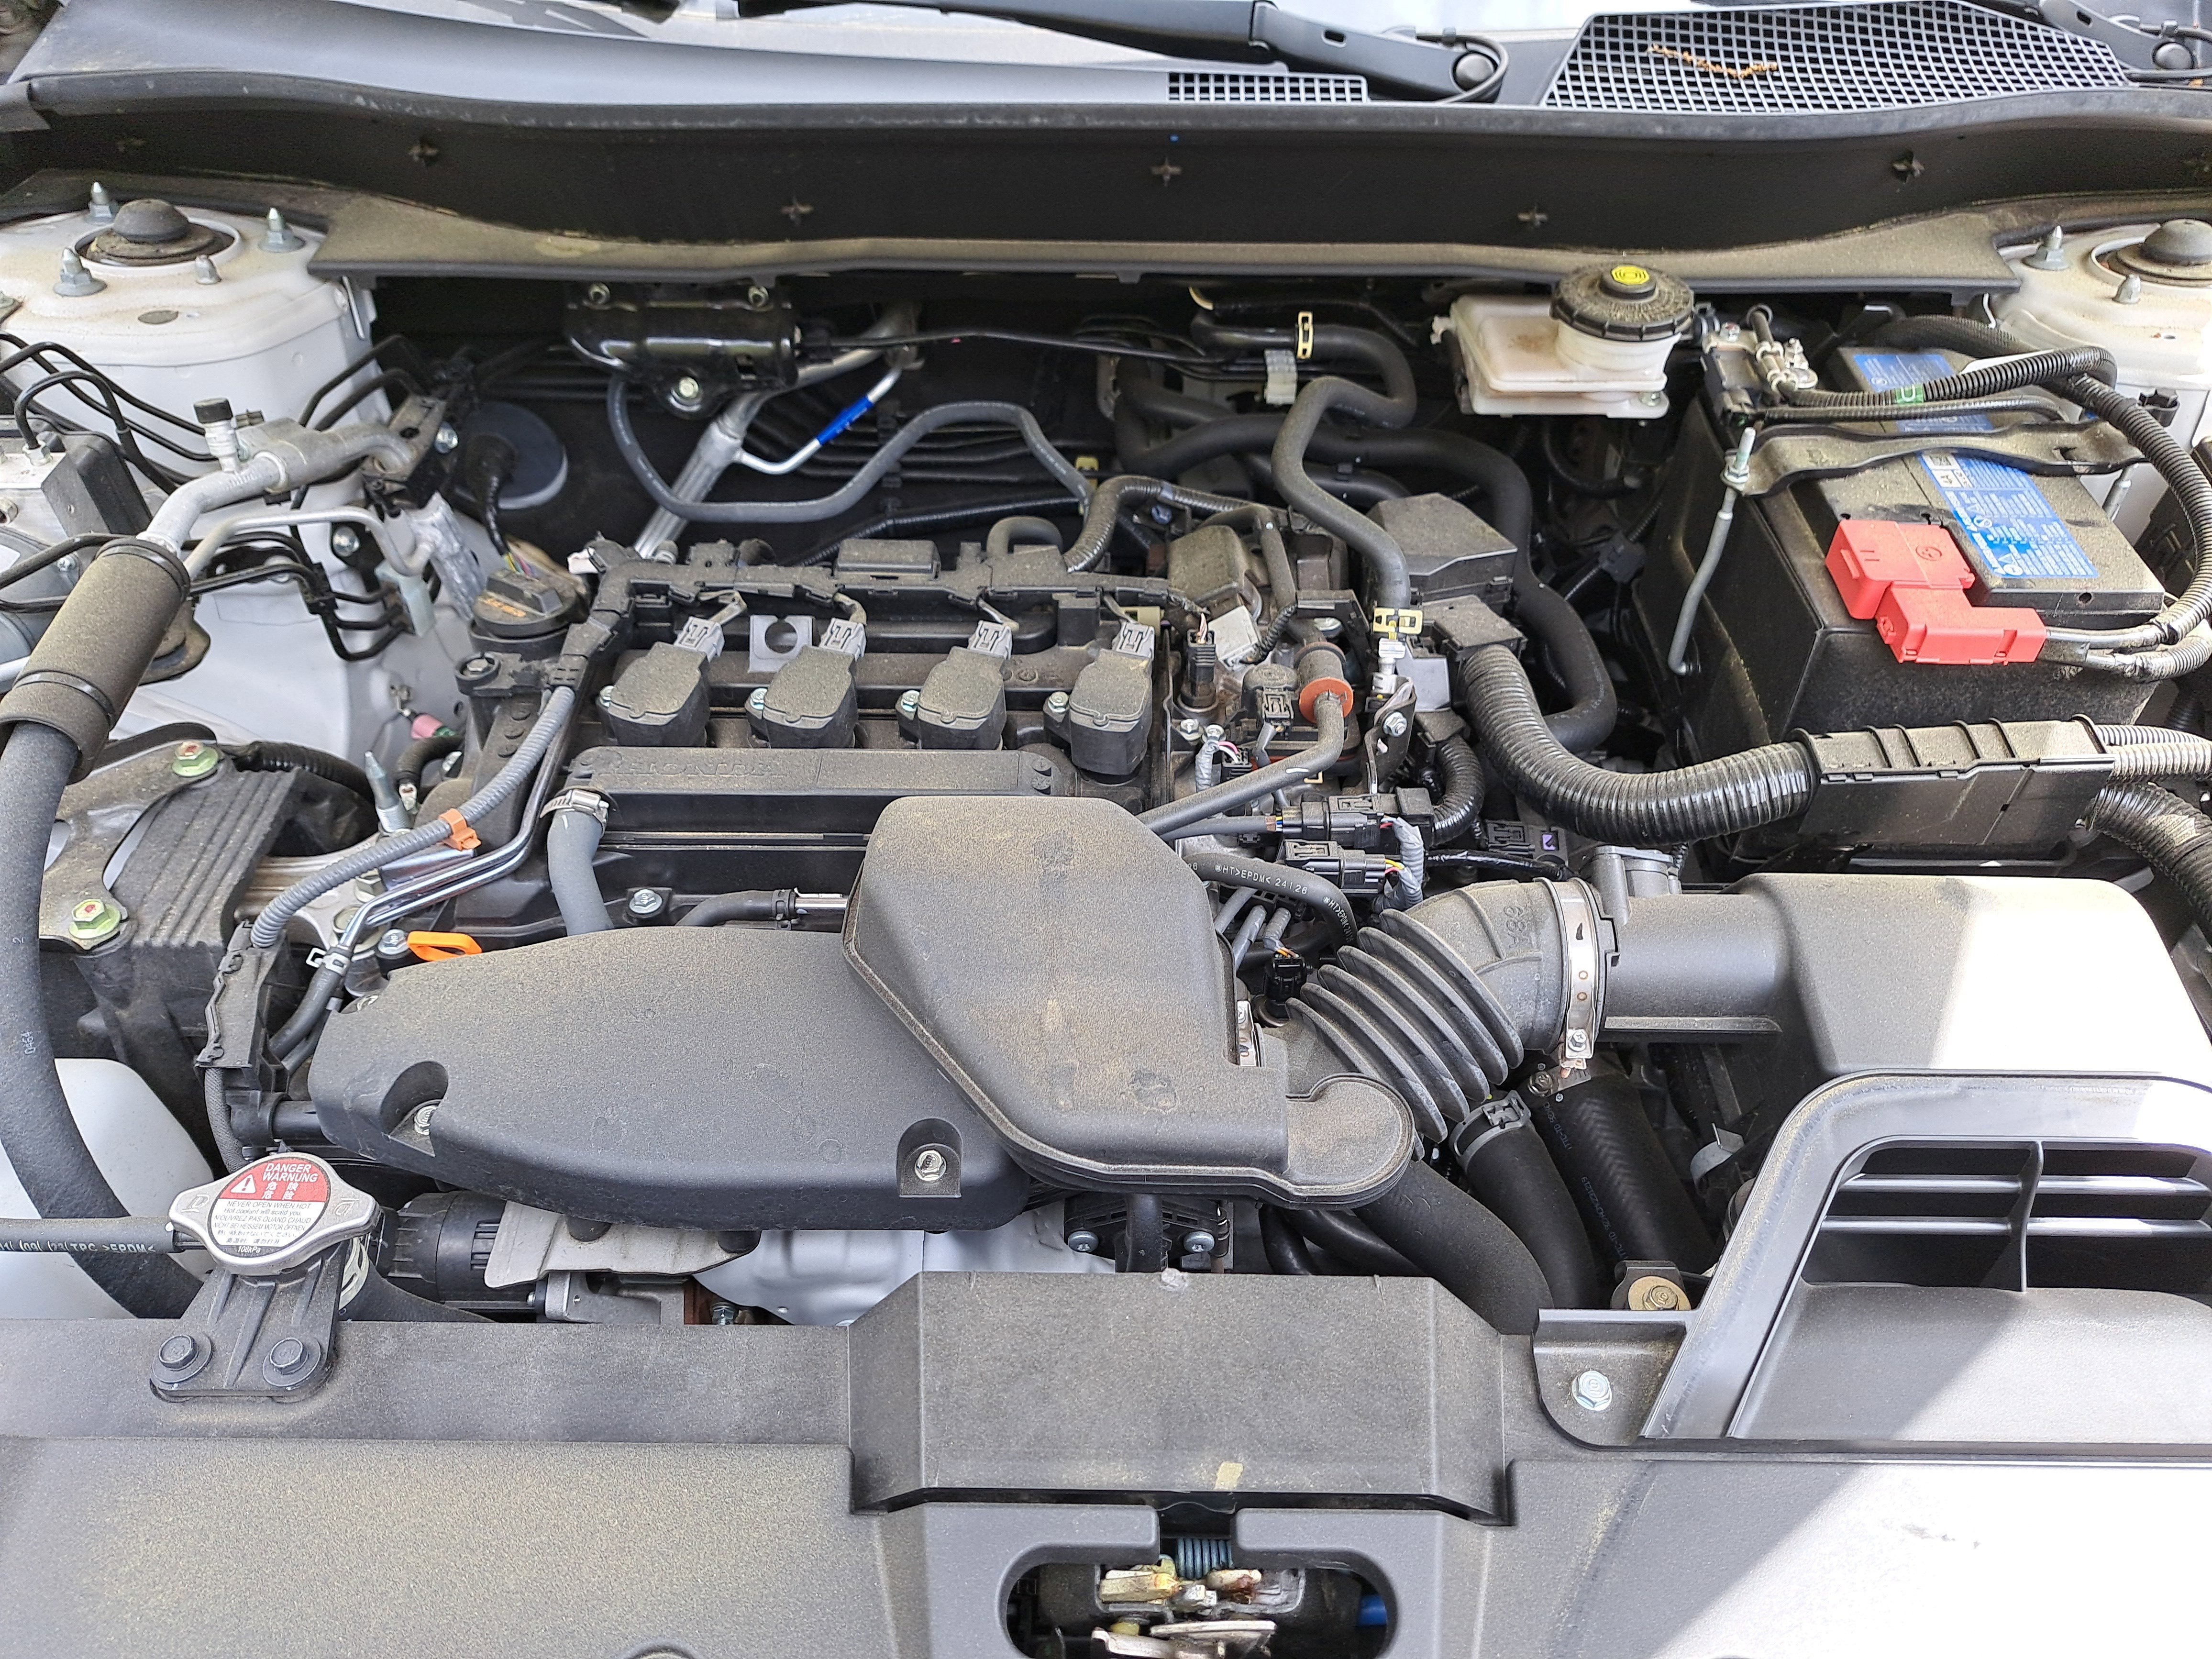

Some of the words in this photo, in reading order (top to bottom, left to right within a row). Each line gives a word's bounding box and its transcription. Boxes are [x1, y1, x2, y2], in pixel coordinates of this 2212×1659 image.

[1274, 877, 1308, 895] 24126
[265, 1163, 311, 1173] DANGER
[262, 1172, 319, 1183] WARNUNG
